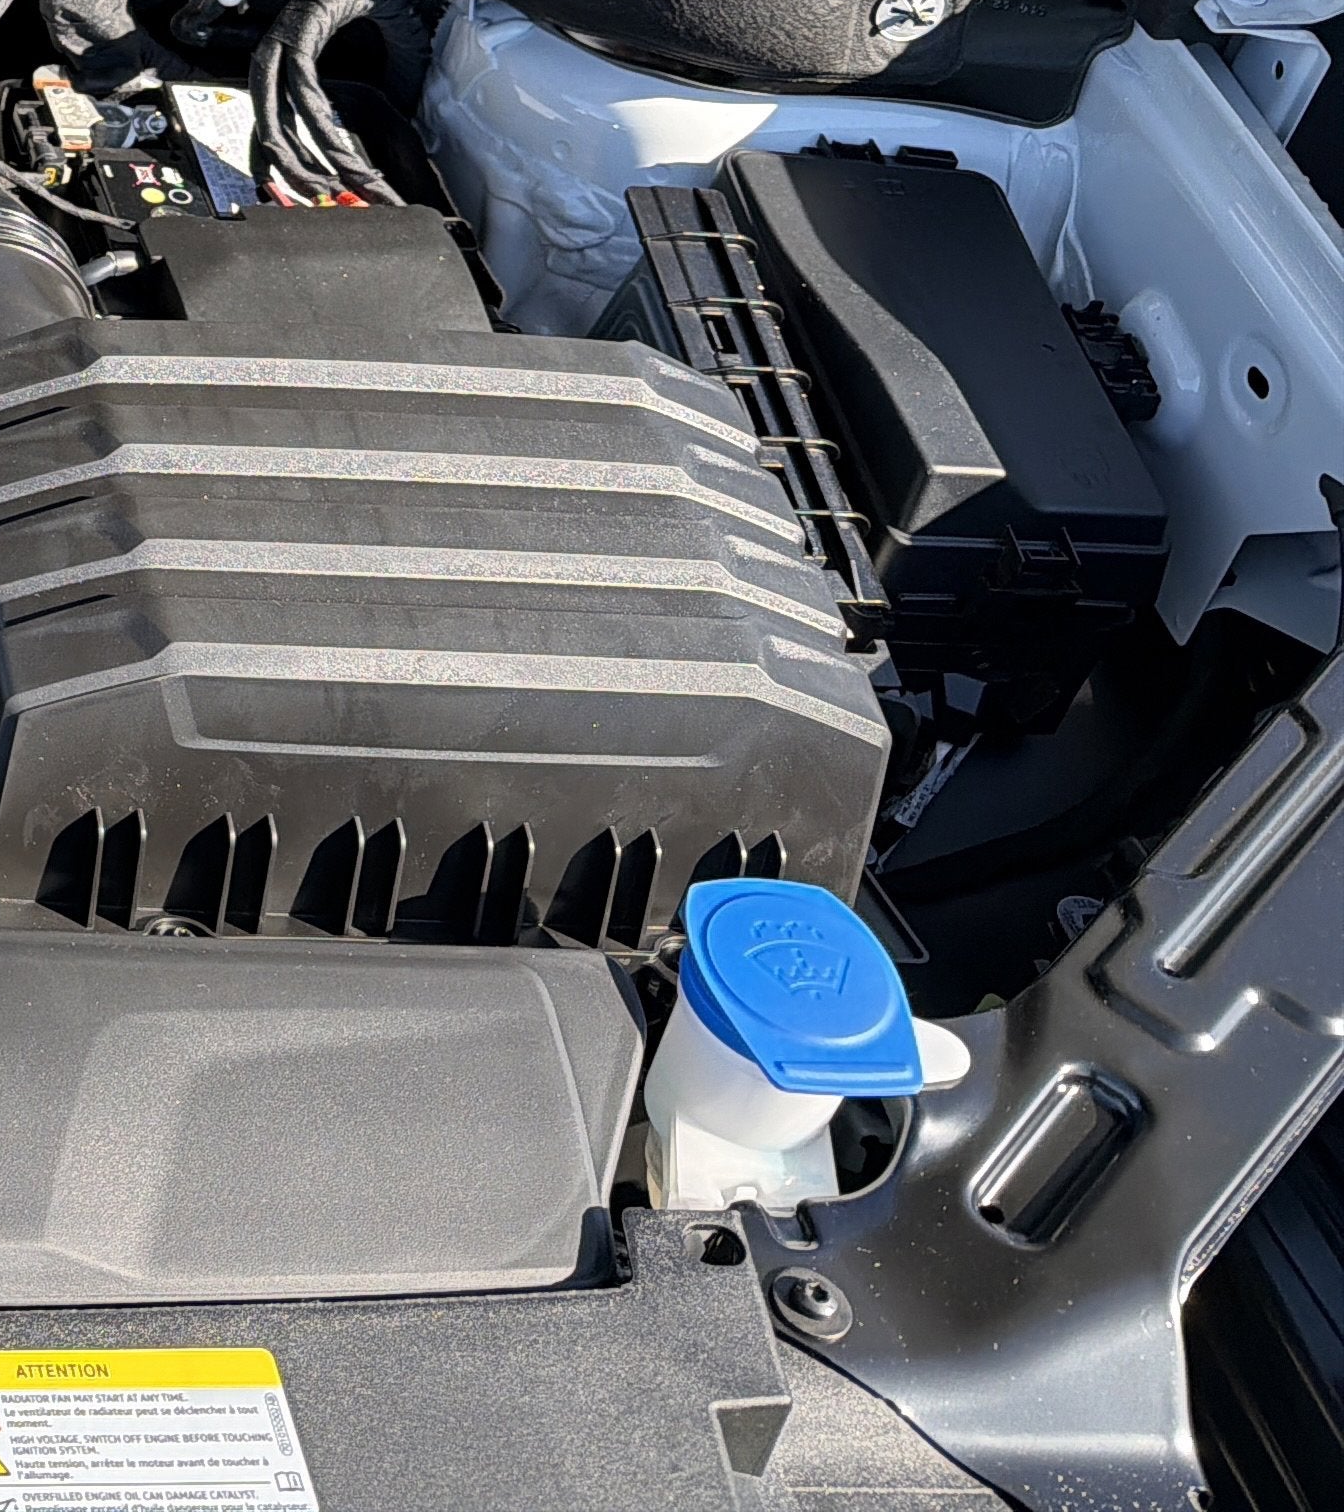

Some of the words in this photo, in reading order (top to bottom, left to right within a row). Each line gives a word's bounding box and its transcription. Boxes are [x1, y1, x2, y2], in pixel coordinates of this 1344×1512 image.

[15, 1363, 110, 1379] ATTENTION
[0, 1394, 49, 1404] RADIATOR
[51, 1394, 71, 1403] FAN
[73, 1394, 93, 1403] MAY
[95, 1394, 125, 1403] START
[127, 1394, 138, 1402] AT
[140, 1393, 160, 1402] ANY
[3, 1408, 16, 1417] Le
[17, 1407, 71, 1417] ventilateur
[73, 1407, 87, 1416] de
[88, 1406, 133, 1416] radiateur
[160, 1408, 172, 1416] se
[237, 1405, 260, 1415] tout
[9, 1435, 35, 1445] HIGH
[84, 1434, 123, 1444] SWITCH
[124, 1434, 142, 1443] OFF
[145, 1433, 181, 1443] ENGINE
[183, 1433, 221, 1443] BEFORE
[222, 1432, 274, 1443] TOUCHING
[12, 1446, 57, 1456] IGNITION
[15, 1460, 46, 1469] Haute
[126, 1458, 137, 1468] le
[139, 1459, 174, 1468] moteur
[177, 1459, 205, 1467] avant
[207, 1458, 220, 1467] de
[222, 1457, 260, 1467] toucher
[22, 1491, 83, 1502] OVERFILLED
[85, 1491, 122, 1501] ENGINE
[124, 1491, 141, 1501] OIL
[142, 1491, 164, 1501] CAN
[165, 1490, 208, 1501] DAMAGE
